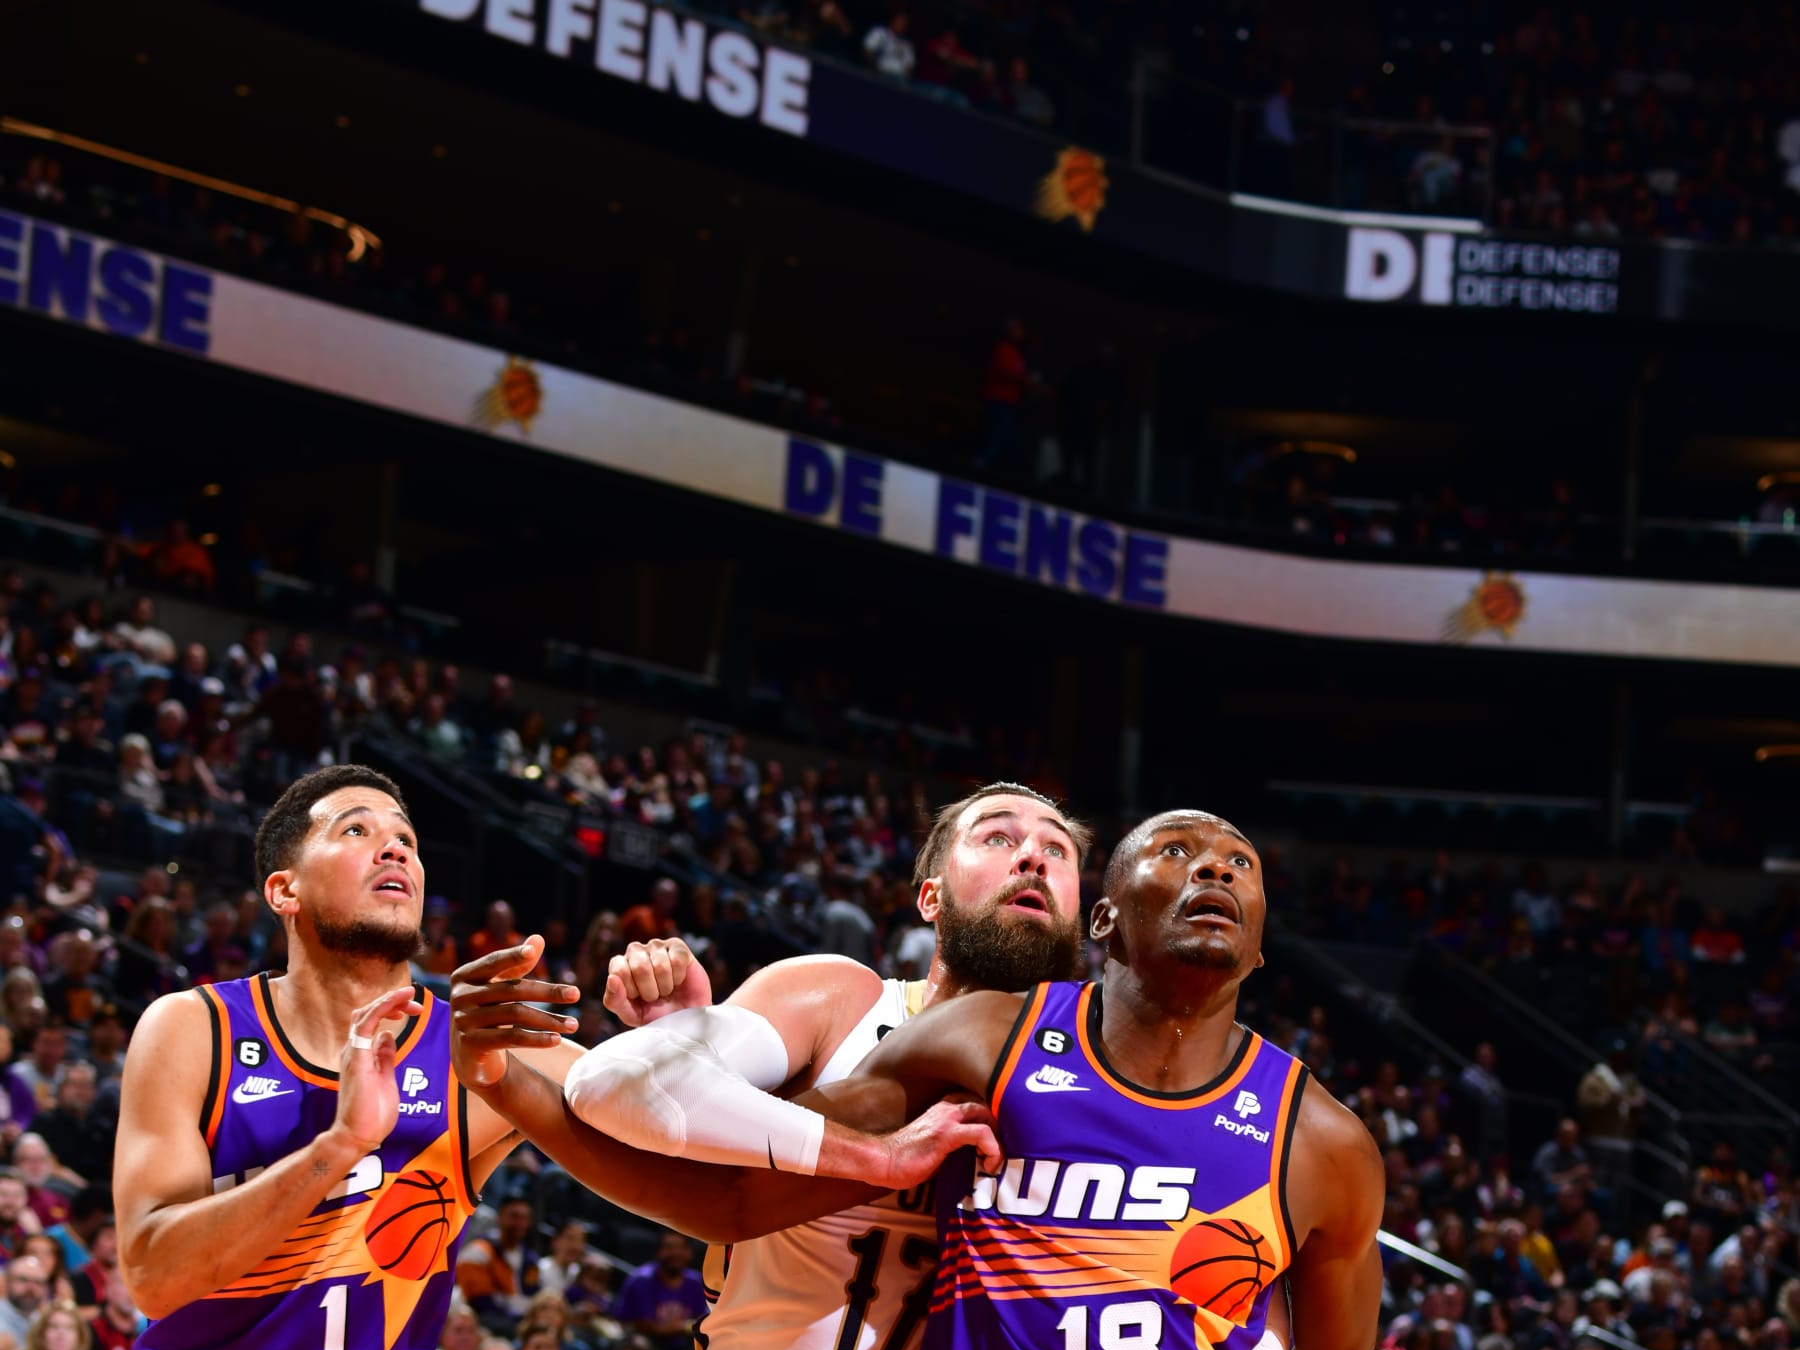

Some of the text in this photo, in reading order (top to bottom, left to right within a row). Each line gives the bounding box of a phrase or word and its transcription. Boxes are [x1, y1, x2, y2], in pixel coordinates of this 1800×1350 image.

[1459, 240, 1620, 278] DEFENSE!
[1457, 274, 1618, 313] DEFENSE!
[784, 435, 1170, 609] DE FENSE
[239, 1041, 261, 1066] 6
[1041, 1031, 1065, 1054] 6
[244, 1076, 281, 1094] NIKE
[1037, 1065, 1078, 1088] NIKE
[398, 1100, 442, 1115] ayPal
[1214, 1114, 1270, 1143] PayPal
